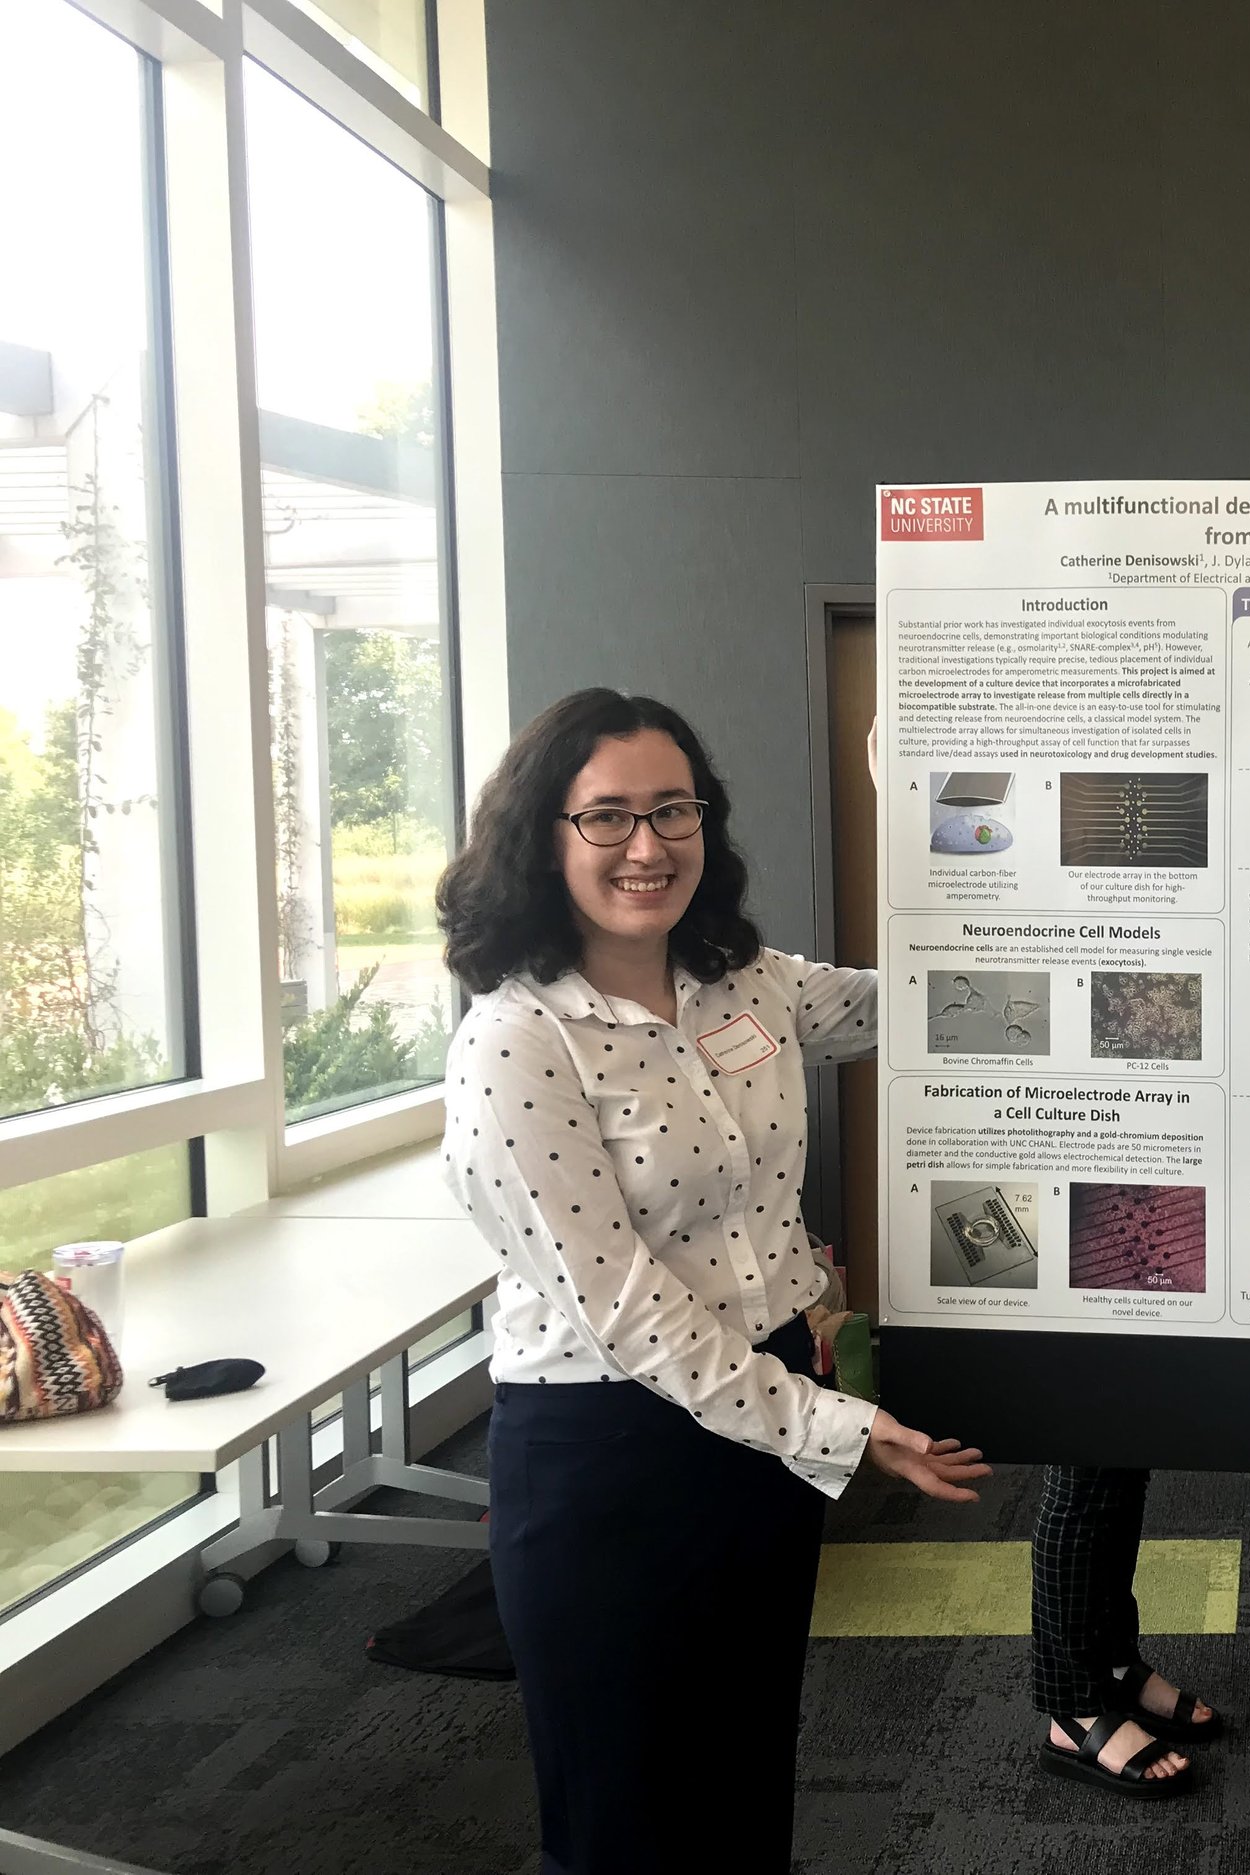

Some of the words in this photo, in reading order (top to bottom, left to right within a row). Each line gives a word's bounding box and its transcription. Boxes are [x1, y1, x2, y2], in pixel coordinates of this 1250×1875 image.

[889, 496, 915, 514] NC
[920, 496, 972, 514] STATE
[1044, 498, 1058, 515] A
[1064, 495, 1218, 514] multifunctional
[891, 515, 973, 532] UNIVERSITY
[1060, 554, 1121, 566] Catherine
[1211, 554, 1220, 566] J.
[1022, 597, 1107, 611] Introduction
[898, 620, 941, 628] Substantial
[943, 620, 962, 629] prior
[963, 620, 983, 628] work
[985, 620, 998, 628] has
[1000, 620, 1046, 629] investigated
[1047, 619, 1084, 627] individual
[1086, 619, 1126, 628] exocytosis
[1128, 619, 1154, 627] events
[1156, 618, 1175, 627] from
[929, 868, 967, 876] Individual
[969, 869, 1016, 877] carbon-fiber
[927, 880, 987, 888] microelectrode
[988, 880, 1018, 890] utilizing
[946, 893, 1000, 901] amperometry.
[962, 923, 1075, 937] Neuroendocrine
[1079, 925, 1104, 938] Cell
[1109, 926, 1160, 939] Models
[942, 1056, 969, 1064] Bovine
[970, 1056, 1013, 1065] Chromaffin
[1126, 1061, 1148, 1070] PC-12
[1150, 1062, 1169, 1070] Cells
[924, 1084, 1002, 1097] Fabrication
[1006, 1085, 1021, 1098] of
[1025, 1086, 1130, 1101] Microelectrode
[1134, 1090, 1172, 1105] Array
[1177, 1090, 1189, 1103] in
[994, 1109, 1001, 1118] a
[1006, 1106, 1030, 1119] Cell
[1035, 1107, 1085, 1120] Culture
[1090, 1109, 1120, 1121] Dish
[936, 1296, 956, 1304] Scale
[977, 1297, 986, 1305] of
[1003, 1298, 1028, 1306] device.
